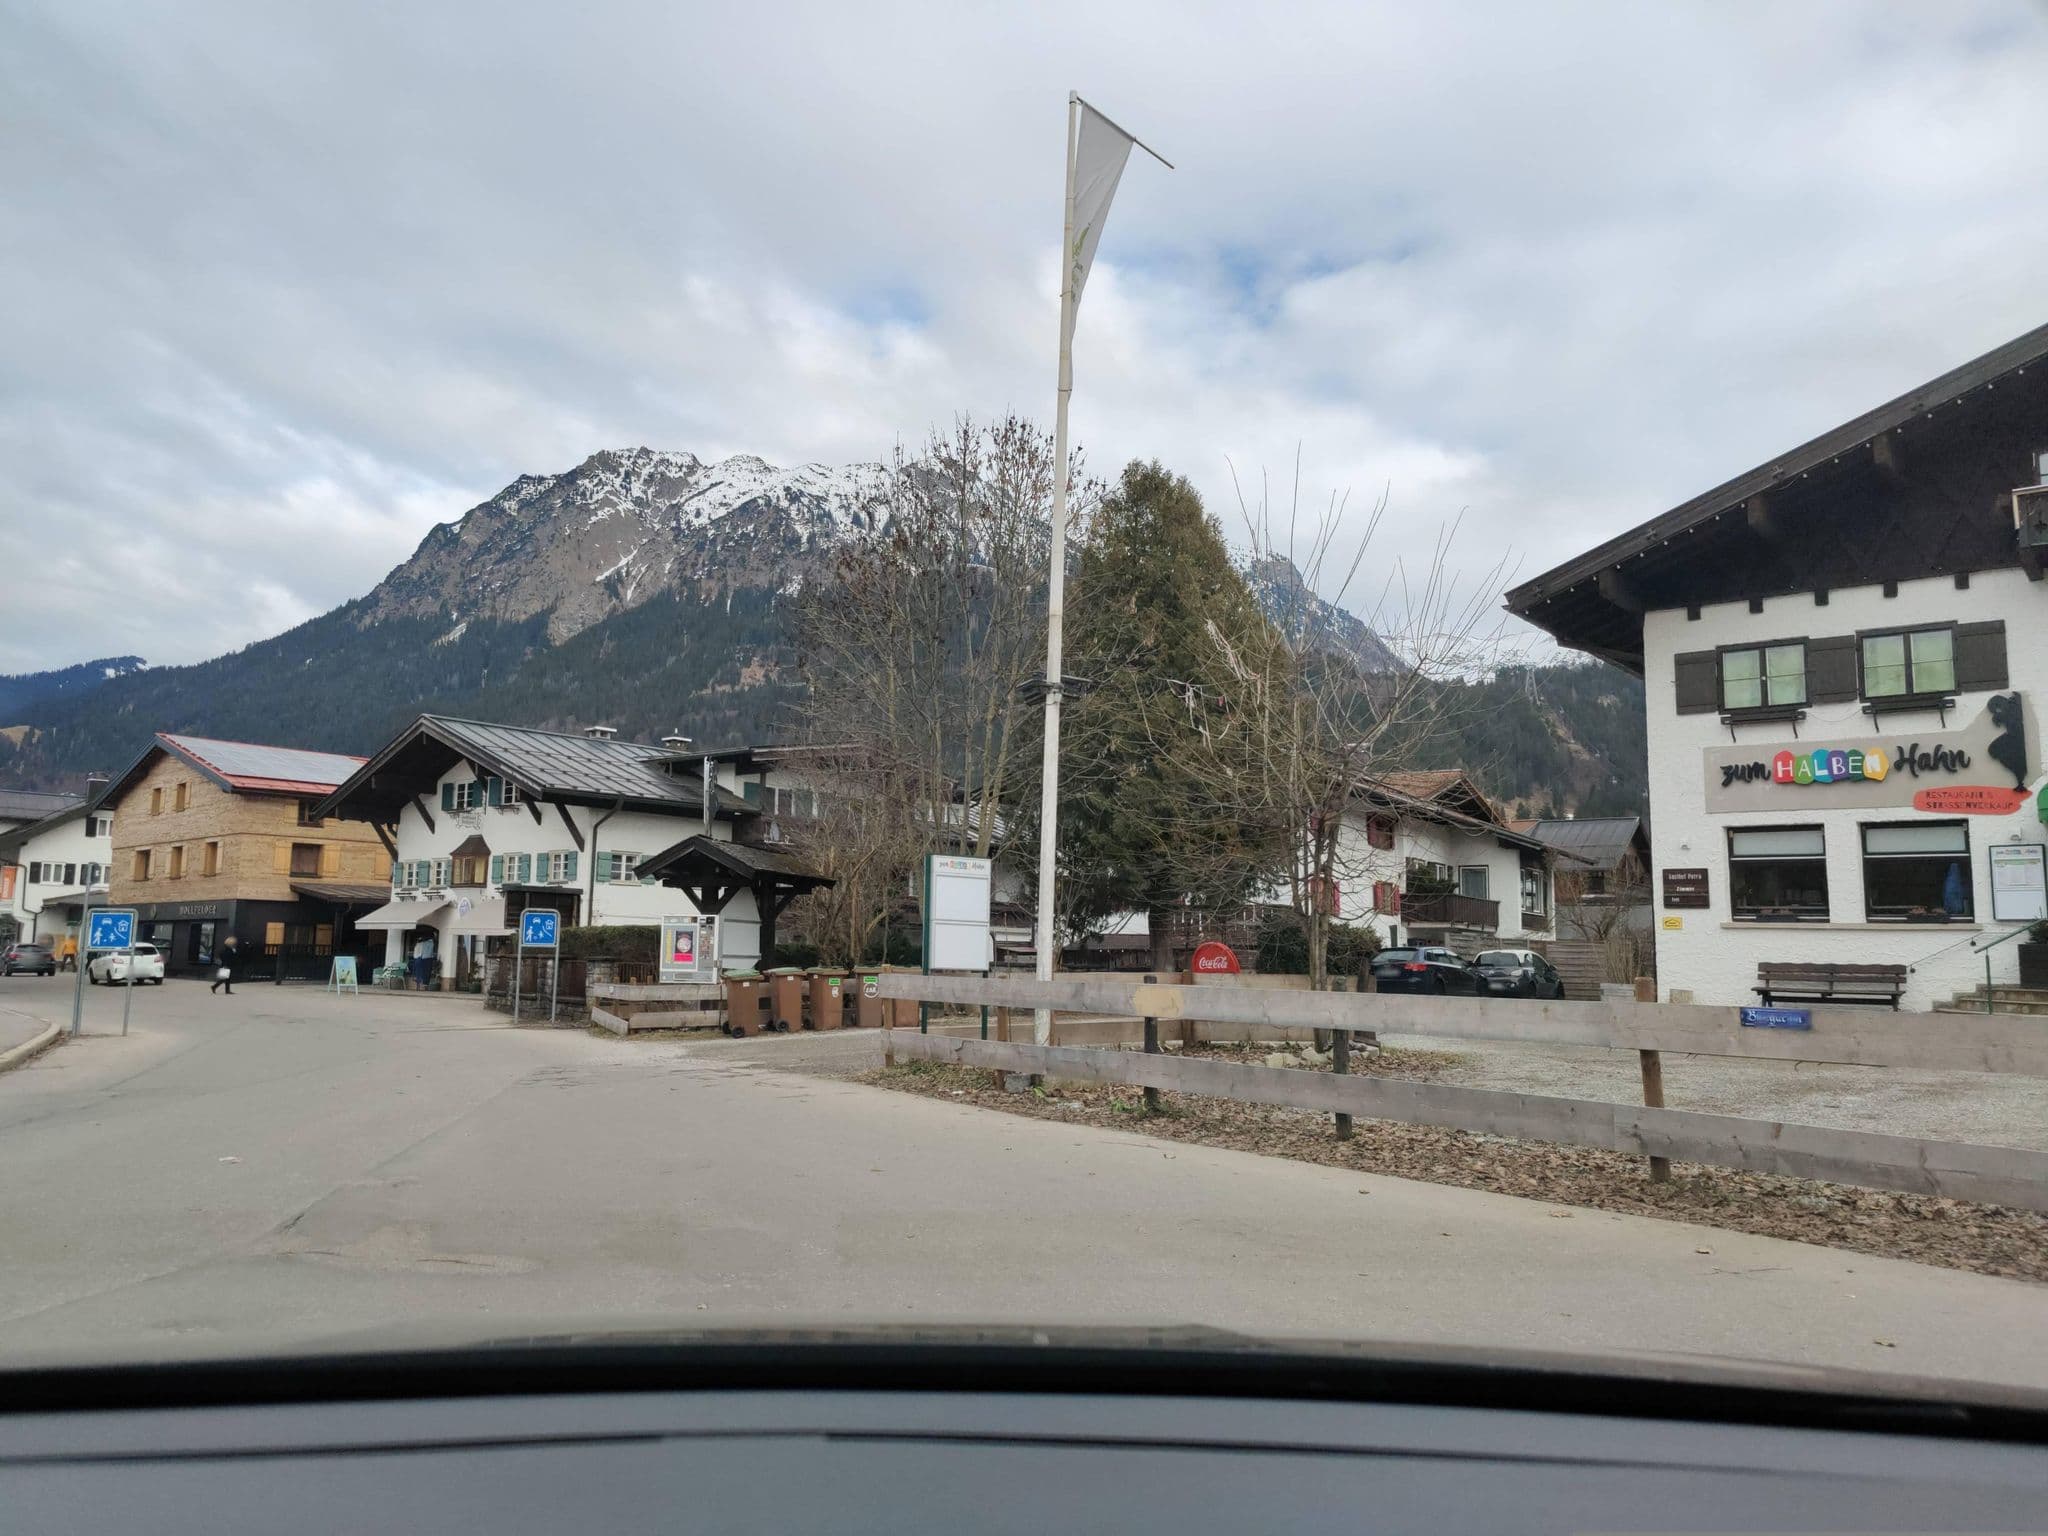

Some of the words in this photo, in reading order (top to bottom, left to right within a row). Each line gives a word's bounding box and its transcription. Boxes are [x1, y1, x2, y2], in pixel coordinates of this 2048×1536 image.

[1720, 761, 1772, 788] zum
[1776, 752, 1883, 778] HALBEN
[1893, 742, 1972, 778] Hahn
[1925, 791, 1984, 799] RESTAURANT
[1199, 957, 1228, 969] Coca-Cola
